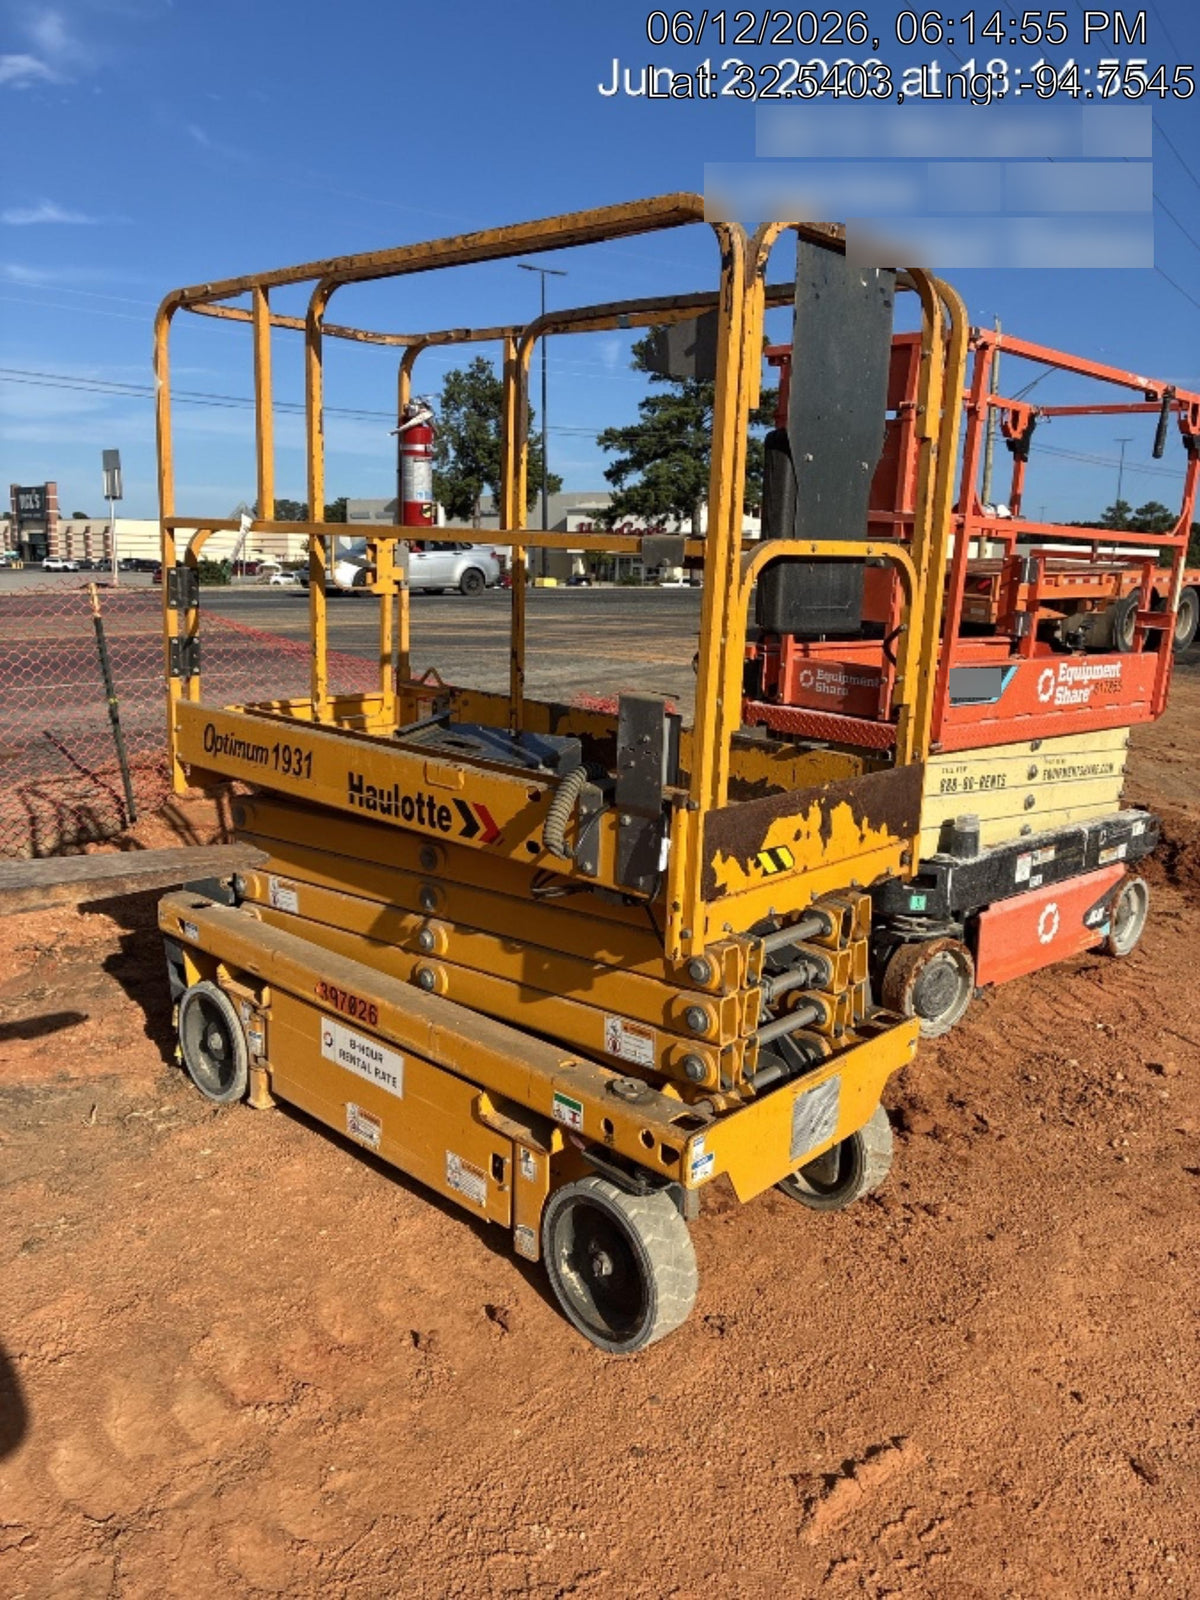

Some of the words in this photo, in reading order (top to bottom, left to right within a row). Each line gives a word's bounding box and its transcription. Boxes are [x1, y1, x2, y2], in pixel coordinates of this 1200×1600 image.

[816, 668, 880, 688] Equipment
[1058, 660, 1122, 686] Equipment
[815, 681, 849, 697] Share
[1054, 684, 1090, 705] Share
[203, 723, 269, 766] Optimum
[272, 742, 313, 779] 1931
[348, 772, 452, 833] Haulotte
[320, 981, 378, 1026] 397026
[349, 1038, 384, 1064] 8-HOUR
[339, 1048, 371, 1075] RENTAL
[374, 1066, 397, 1089] RATE
